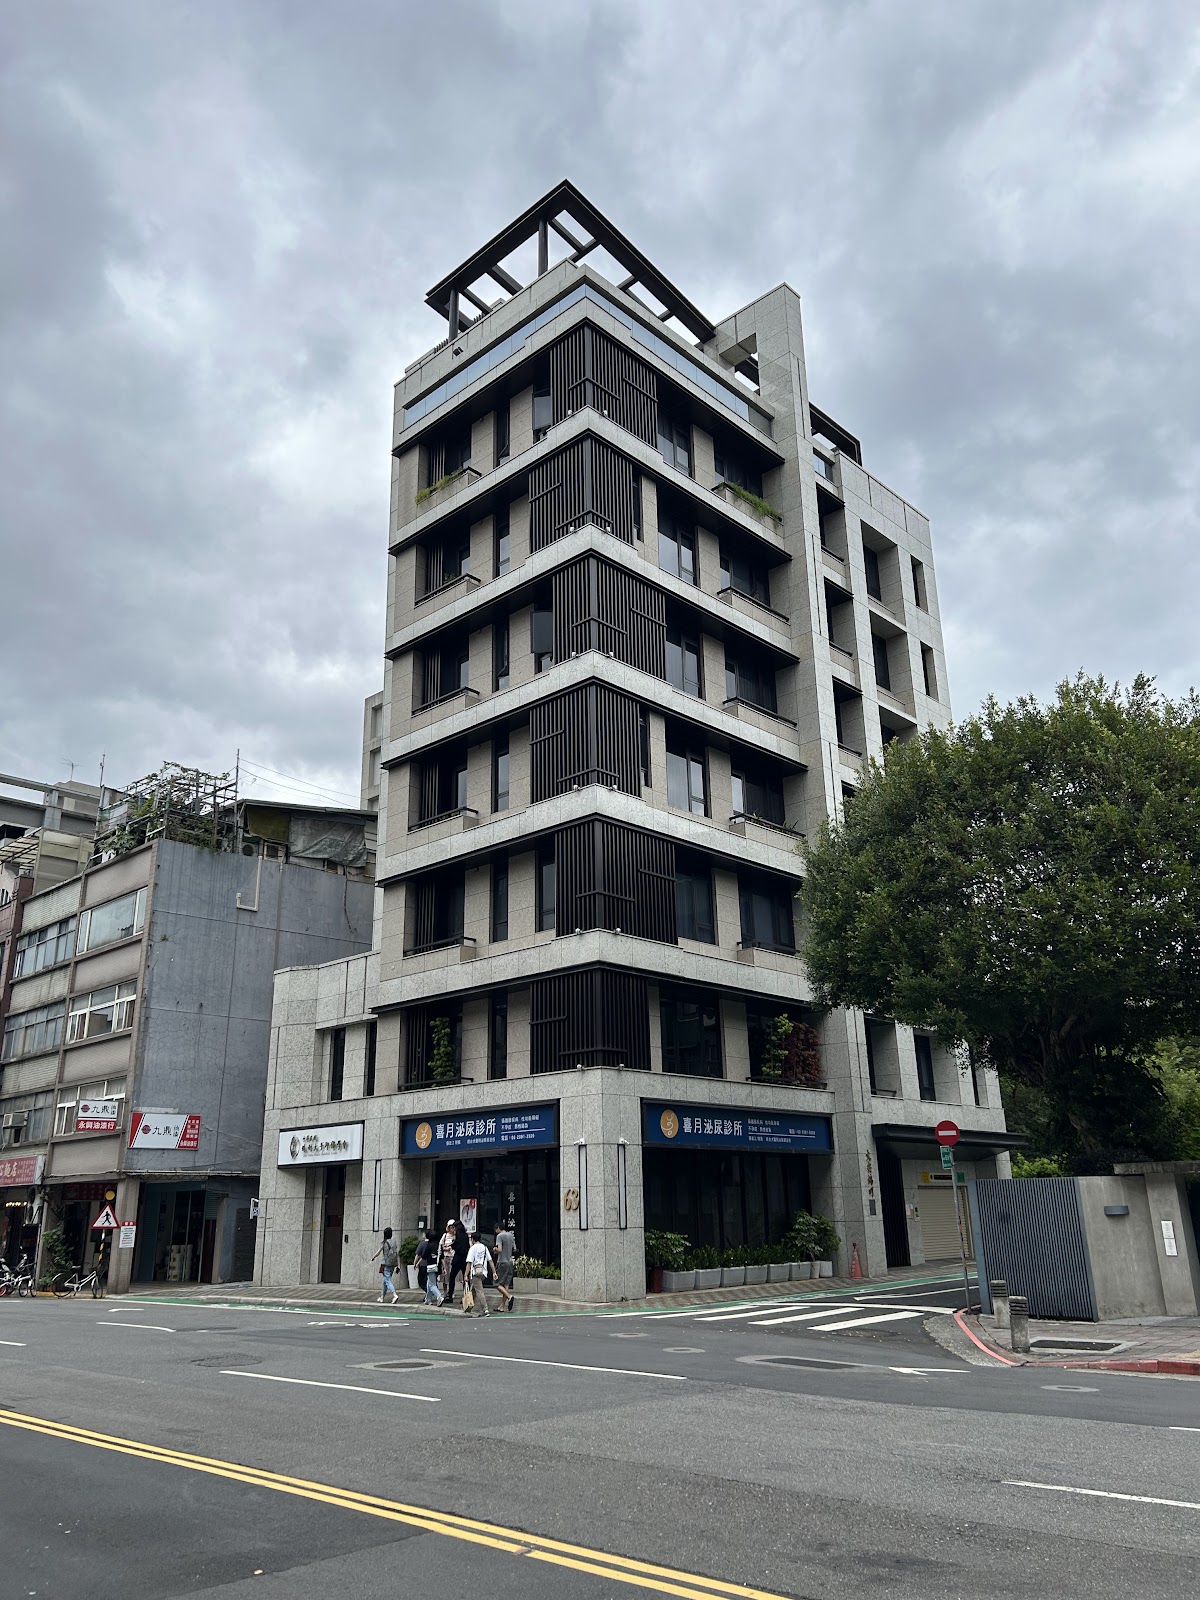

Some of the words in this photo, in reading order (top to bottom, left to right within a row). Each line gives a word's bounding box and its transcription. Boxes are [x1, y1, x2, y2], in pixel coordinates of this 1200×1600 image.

[91, 1105, 110, 1114] 九鼎
[152, 1125, 172, 1136] 九鼎
[435, 1118, 496, 1139] 喜月泌尿診所
[682, 1117, 743, 1136] 喜月泌尿診所
[563, 1188, 579, 1211] 63
